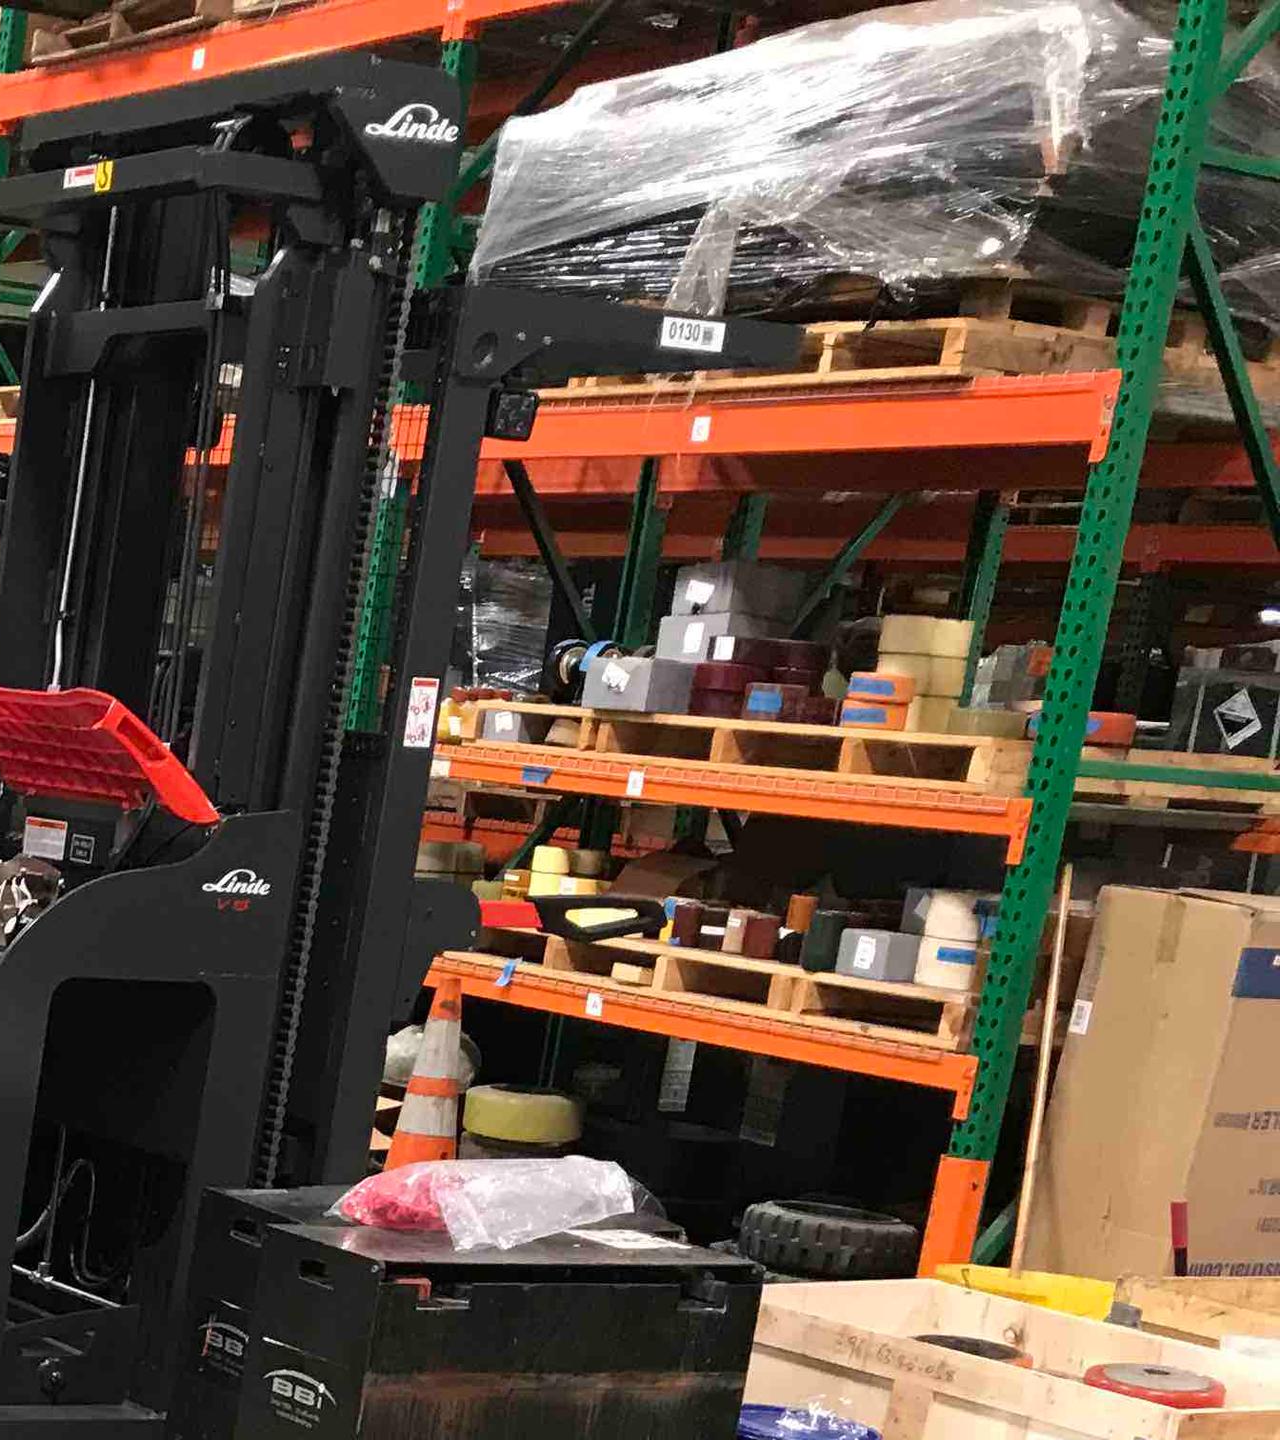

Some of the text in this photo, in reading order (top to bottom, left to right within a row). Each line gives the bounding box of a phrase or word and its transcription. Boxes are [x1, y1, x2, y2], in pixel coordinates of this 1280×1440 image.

[364, 103, 460, 142] Linde
[669, 321, 700, 341] 0130
[202, 868, 271, 895] Linde
